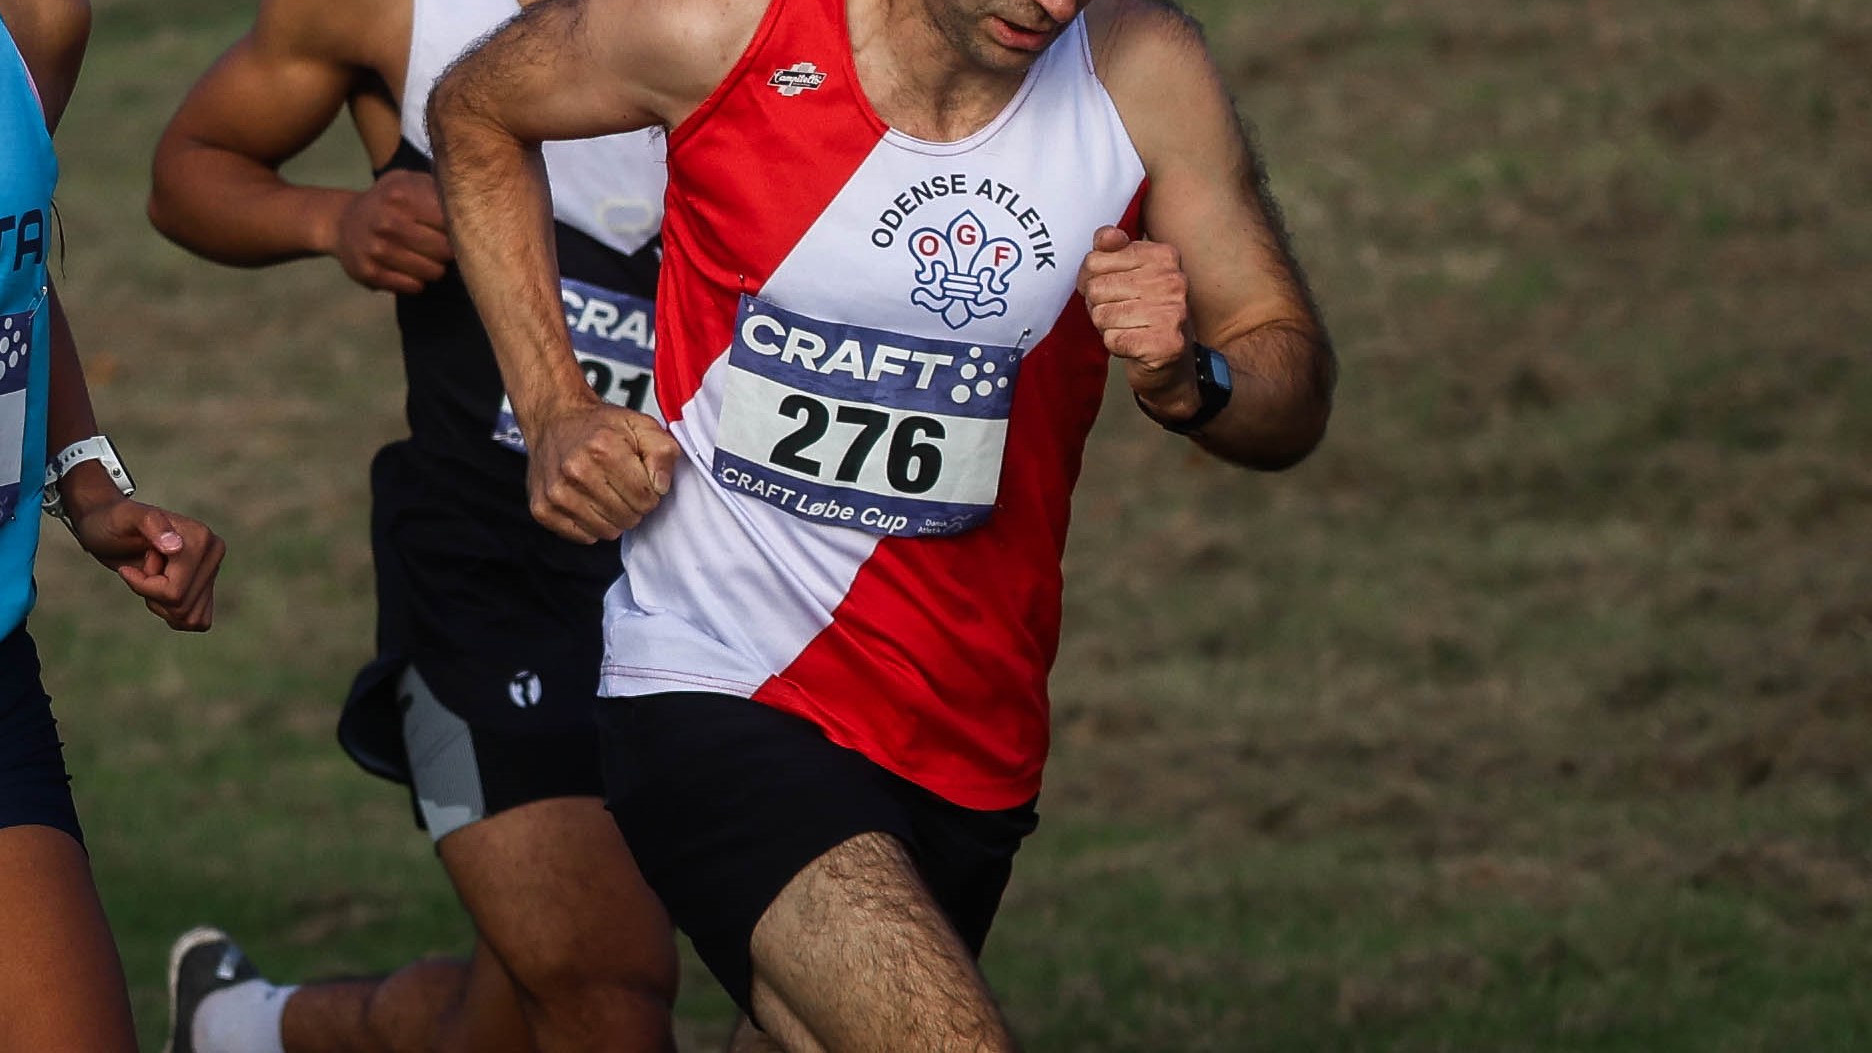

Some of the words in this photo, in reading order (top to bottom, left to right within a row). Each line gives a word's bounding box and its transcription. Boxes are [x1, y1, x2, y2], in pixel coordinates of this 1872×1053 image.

[871, 174, 967, 249] ODENSE
[975, 178, 1057, 271] ATLETIK
[561, 288, 656, 351] CRA
[740, 313, 954, 391] CRAFT
[768, 393, 946, 495] 276
[721, 468, 797, 505] CRAFT
[795, 493, 855, 523] Løbe
[859, 507, 908, 534] Cup
